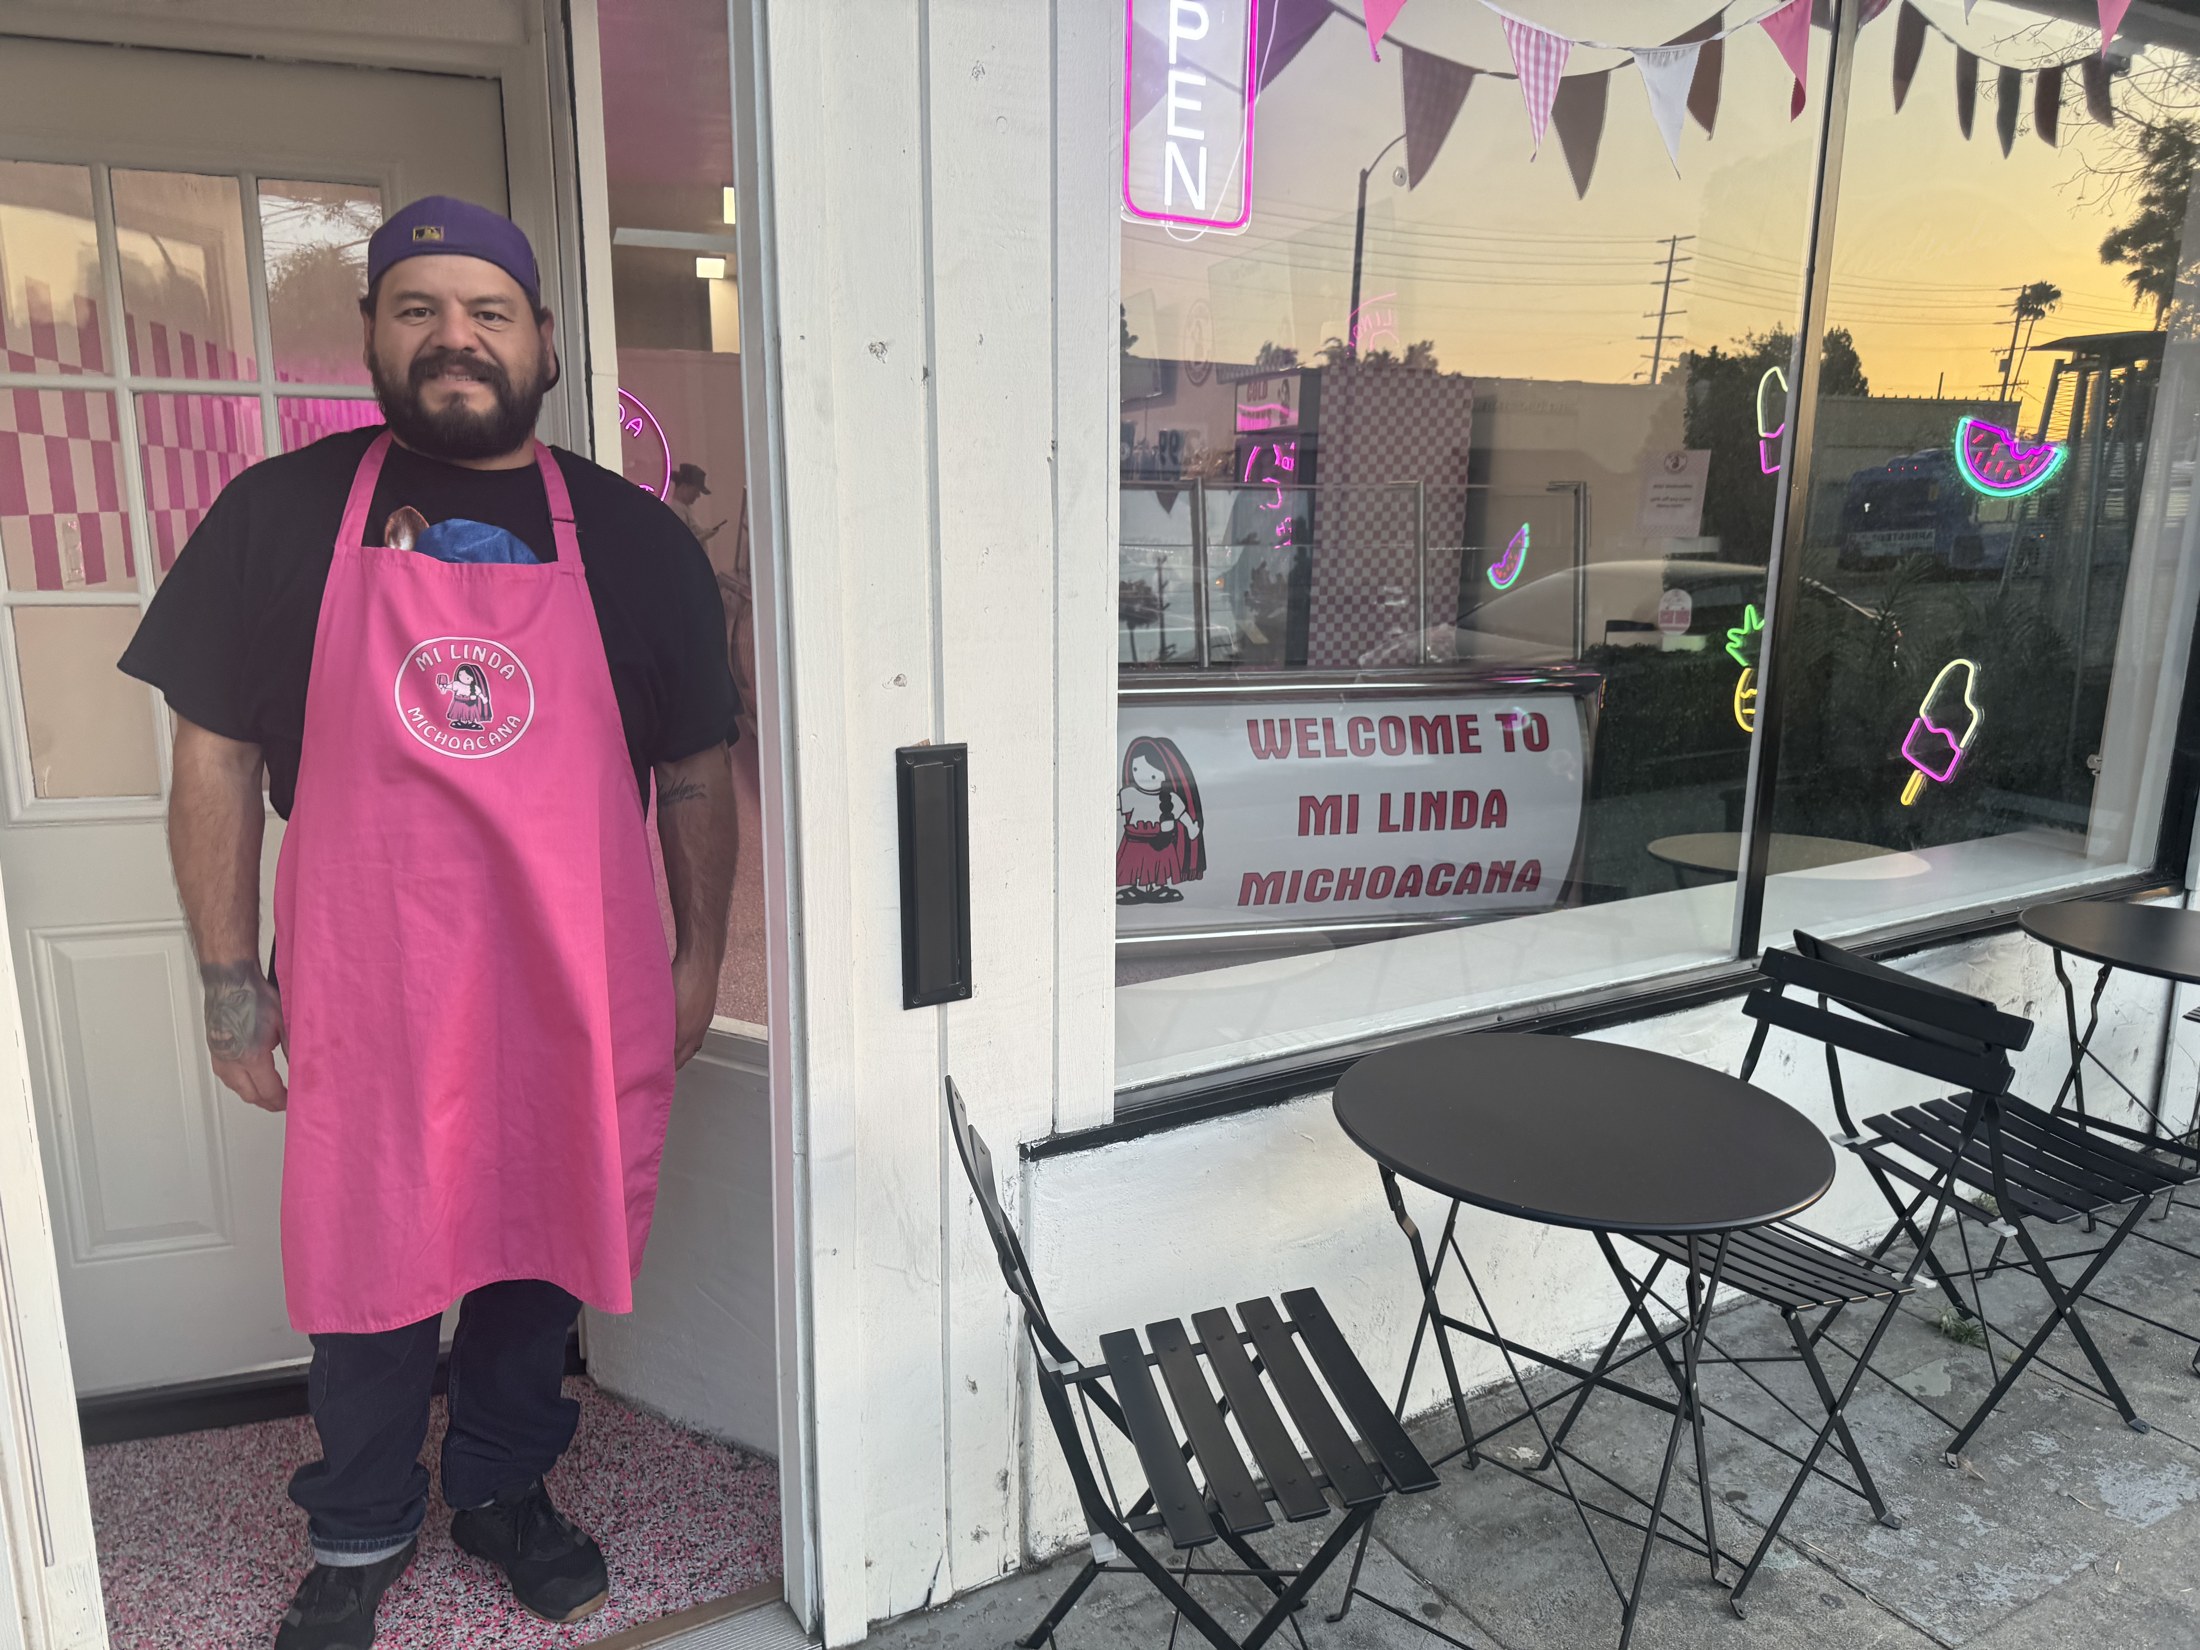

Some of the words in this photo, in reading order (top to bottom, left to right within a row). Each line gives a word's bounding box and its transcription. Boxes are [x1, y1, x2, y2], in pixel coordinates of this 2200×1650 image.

[415, 647, 442, 672] MI
[450, 644, 516, 680] LINDA
[407, 707, 521, 750] MICHOACANA
[1246, 714, 1482, 760] WELCOME
[1494, 712, 1550, 753] TO
[1297, 793, 1360, 837] MI
[1378, 788, 1508, 834] LINDA
[1237, 859, 1542, 906] MICHOACANA
